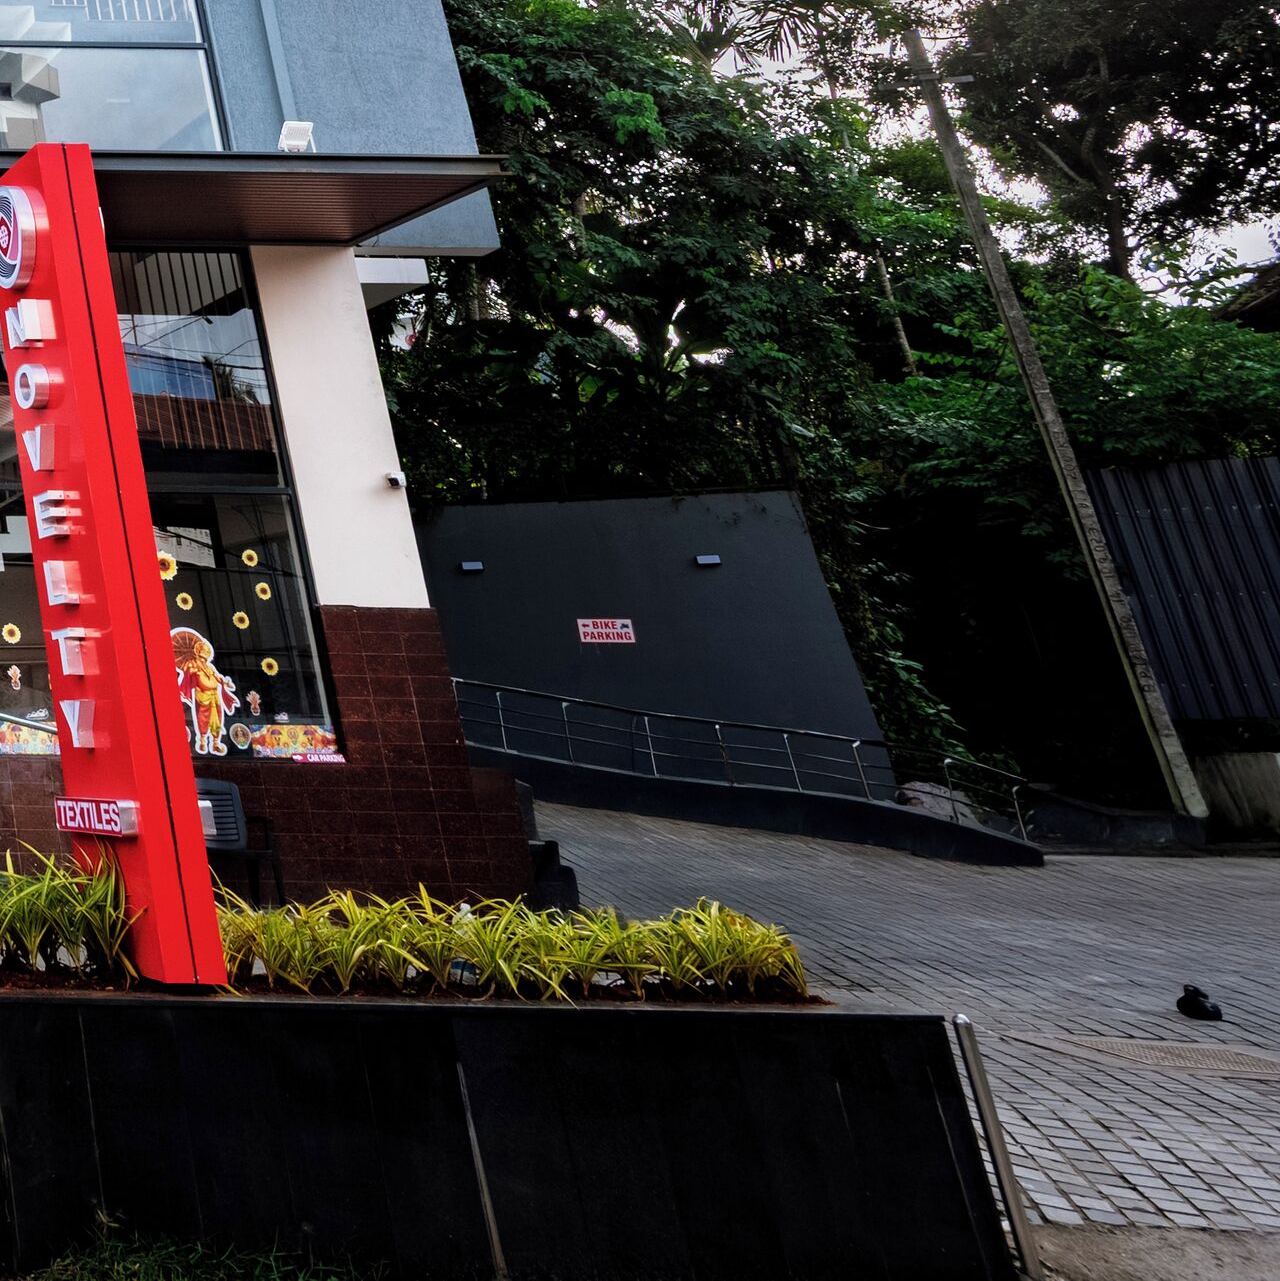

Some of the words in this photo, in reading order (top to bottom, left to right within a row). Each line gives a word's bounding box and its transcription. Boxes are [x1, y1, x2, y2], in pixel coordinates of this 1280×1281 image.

[5, 298, 90, 749] NOVELTY
[591, 620, 618, 630] BIKE
[582, 631, 632, 641] PARKING
[306, 753, 320, 763] CAR
[56, 799, 122, 833] TEXTILES
